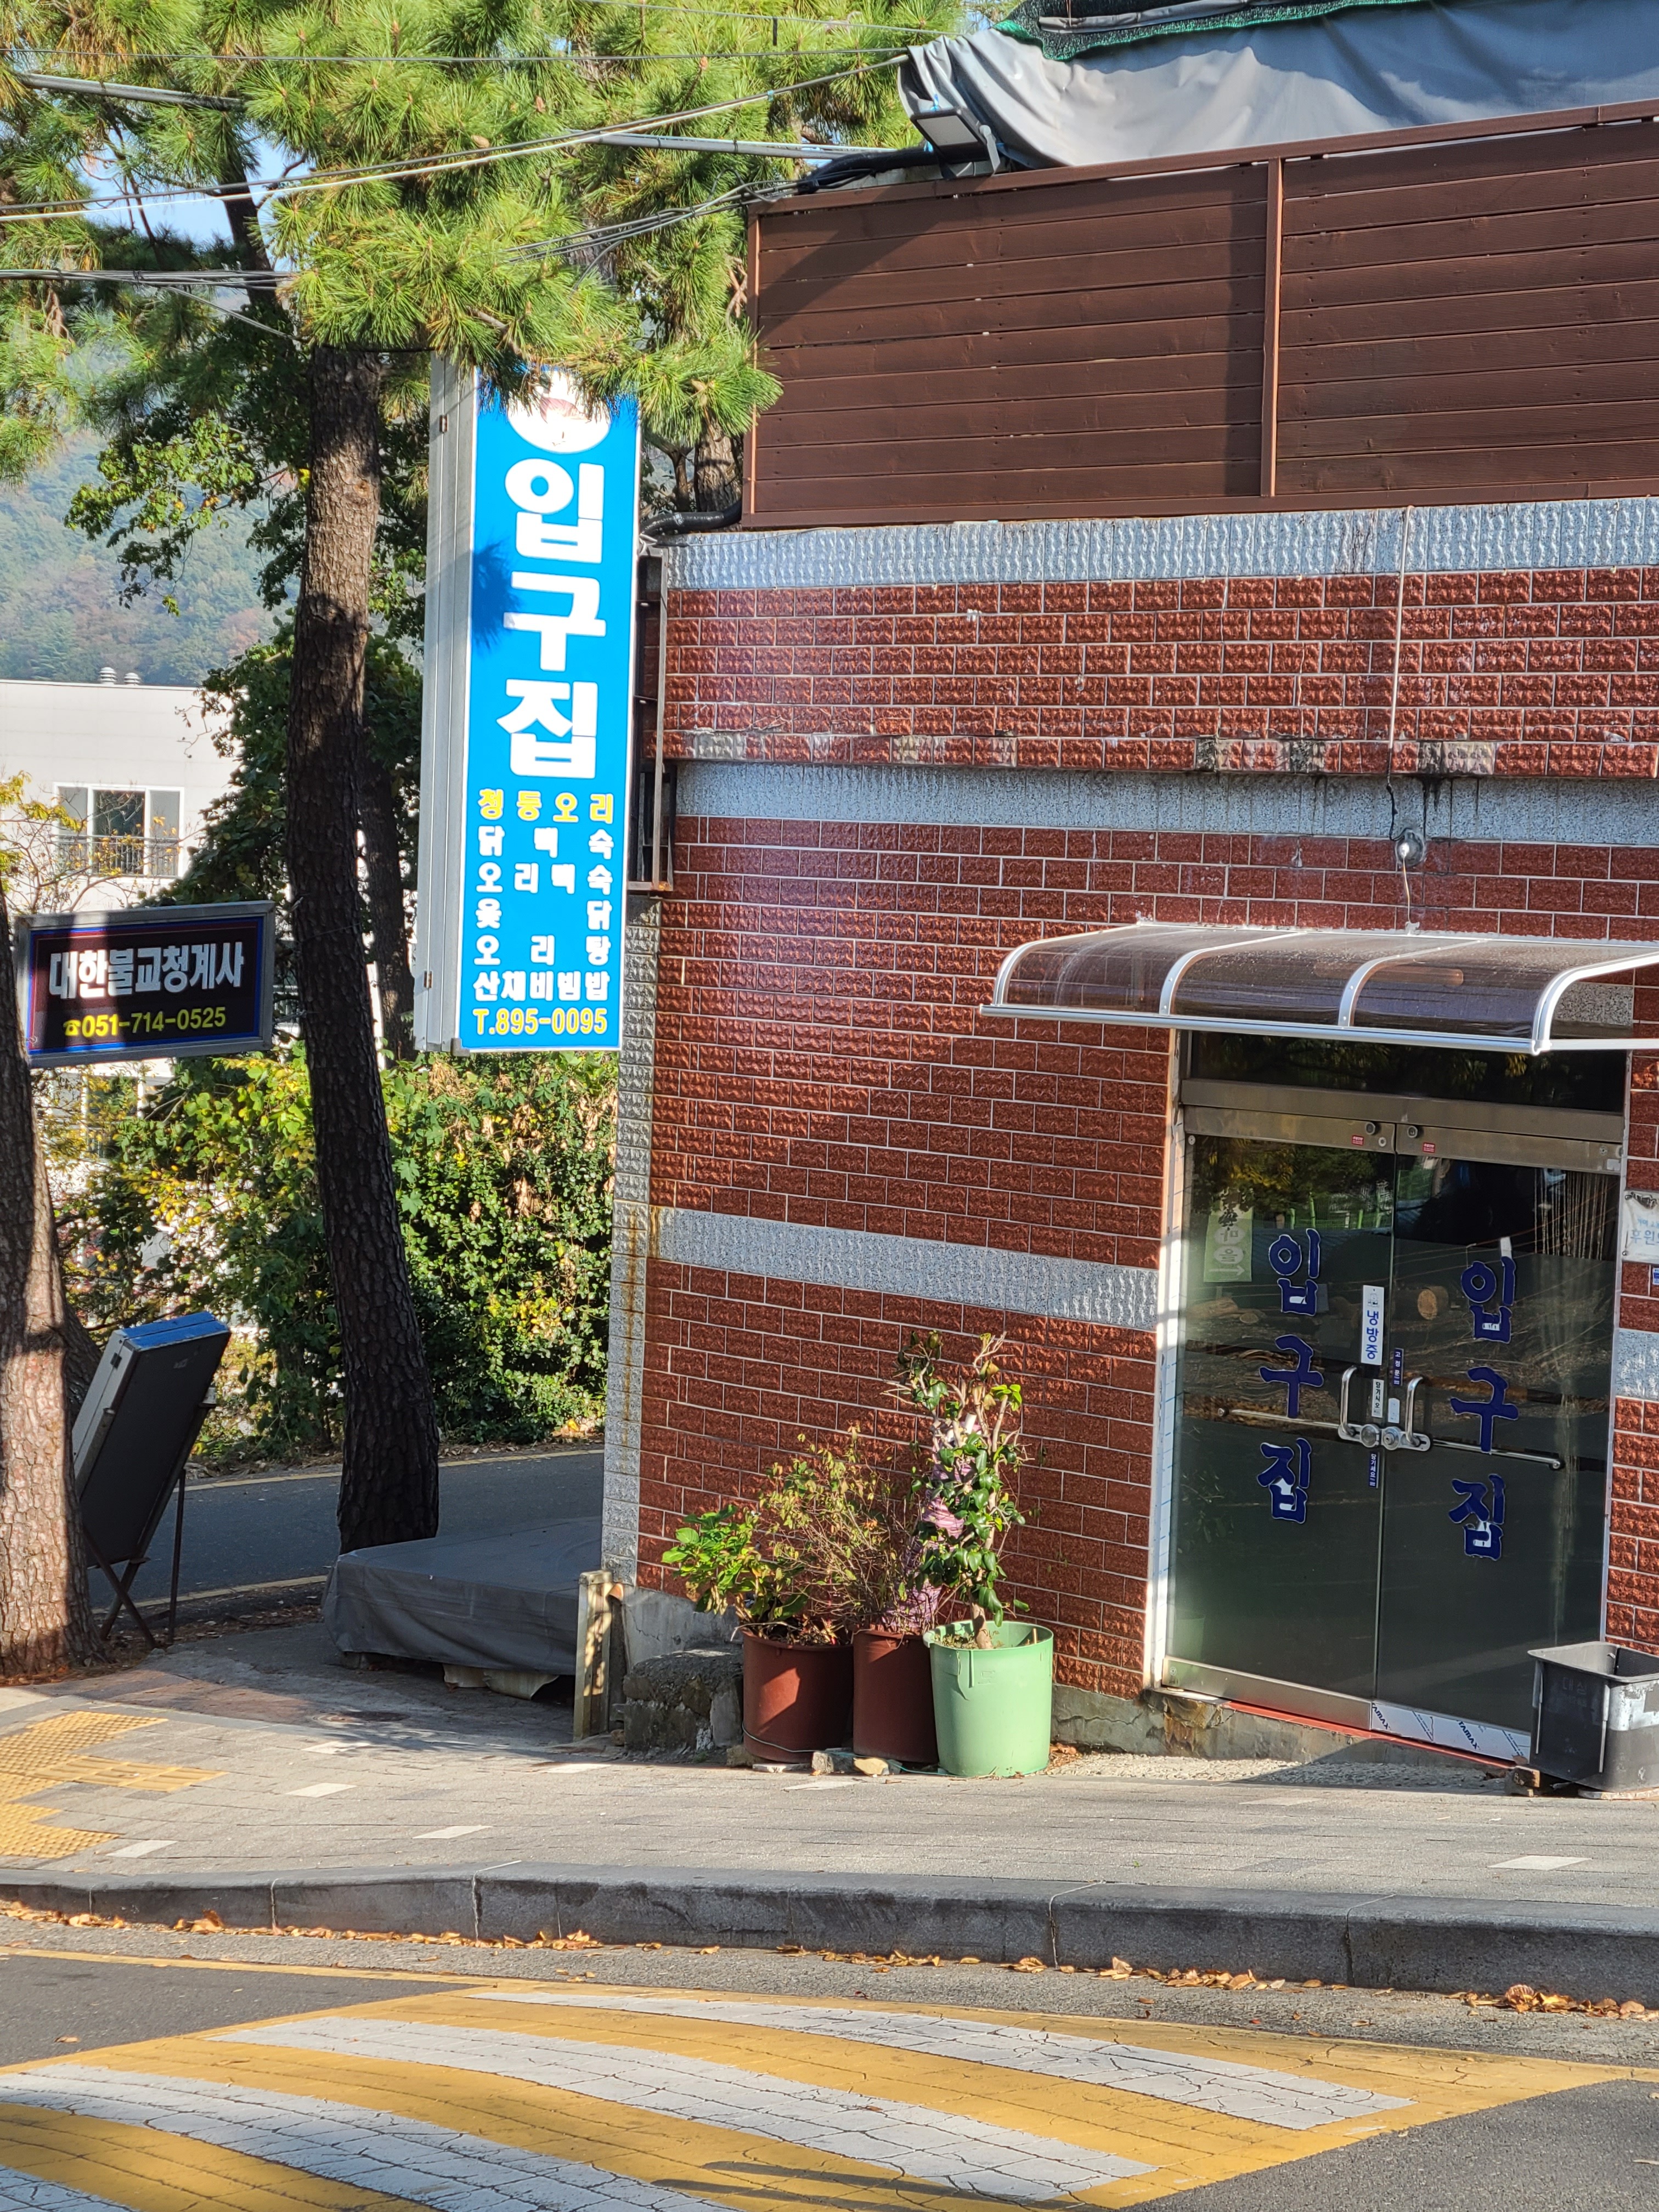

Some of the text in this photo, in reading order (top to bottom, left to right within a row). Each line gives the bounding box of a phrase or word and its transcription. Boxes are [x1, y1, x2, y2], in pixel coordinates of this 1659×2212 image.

[496, 458, 607, 778] 입구집
[477, 825, 614, 860] 닭백숙
[476, 861, 613, 895] 오리백숙
[473, 935, 611, 966] 오리탕
[49, 941, 244, 1000] 대한불교청계사
[473, 970, 611, 1002] 산채비빔밥
[82, 1007, 225, 1037] 051-714-0525
[473, 1007, 608, 1035] T.895-0095
[1365, 1310, 1379, 1359] 냉방중
[1257, 1228, 1324, 1524] 입구집
[1448, 1256, 1519, 1561] 입구집
